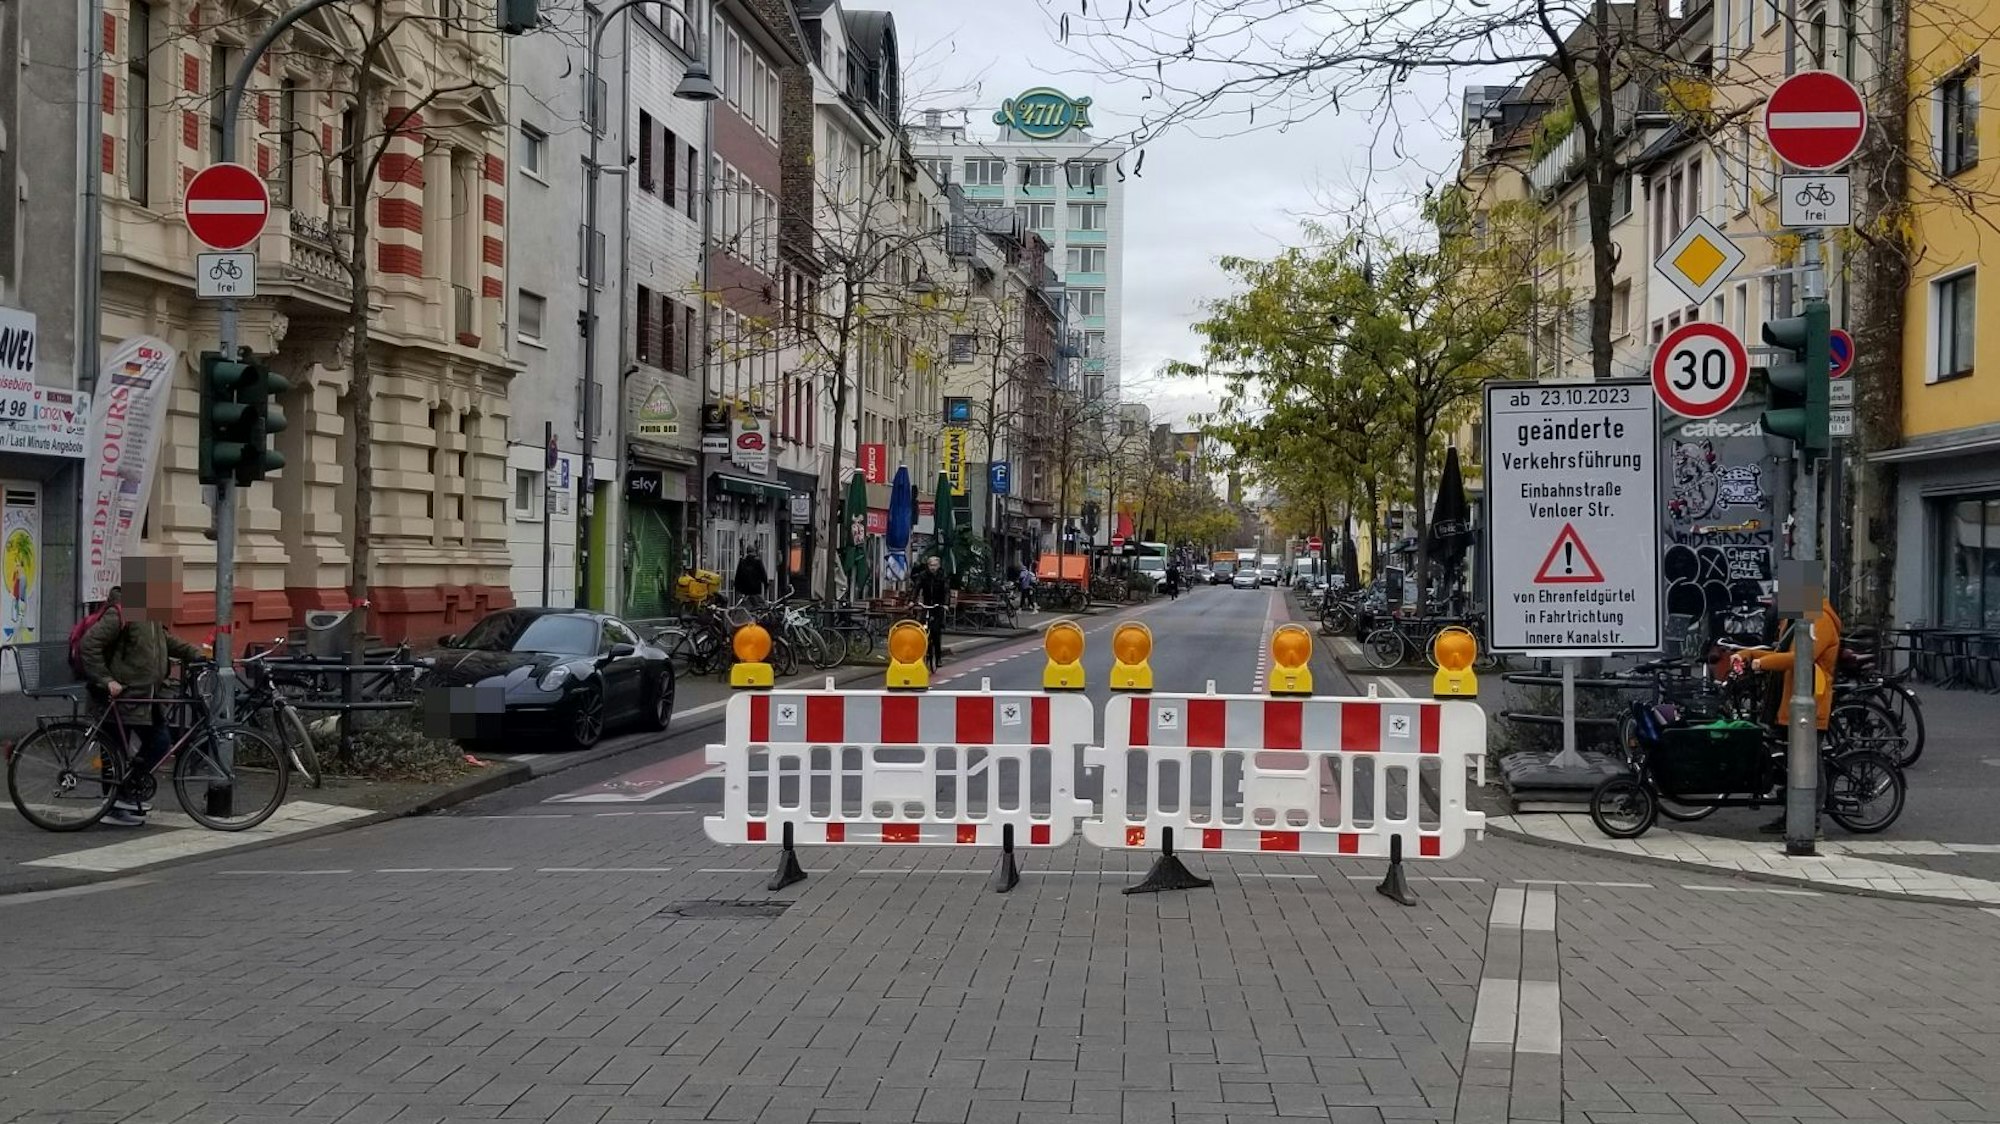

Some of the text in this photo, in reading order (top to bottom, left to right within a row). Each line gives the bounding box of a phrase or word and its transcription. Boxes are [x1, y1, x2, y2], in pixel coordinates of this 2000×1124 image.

[1804, 209, 1827, 221] frei
[217, 281, 236, 293] frei
[1672, 349, 1727, 391] 30
[0, 374, 33, 392] isebüro
[1510, 388, 1630, 406] ab 23.10.2023
[9, 400, 27, 417] 98
[99, 385, 129, 482] TOURS
[1518, 416, 1624, 446] geänderte
[10, 433, 26, 448] Last
[27, 435, 51, 450] Minute
[50, 438, 84, 454] Angebote
[866, 447, 878, 481] tipico
[949, 434, 960, 490] ZEEMAN
[1502, 450, 1641, 471] Verkehrsführung
[631, 476, 657, 493] sky
[1521, 481, 1621, 498] Einbahnstraße
[1529, 501, 1615, 518] Venloer Str.
[91, 490, 112, 566] DEDE
[1513, 588, 1635, 605] von Ehrenfeldgürtel
[1525, 609, 1624, 626] in Fahrtrichtung
[1525, 629, 1624, 644] Innere Kanalstr.
